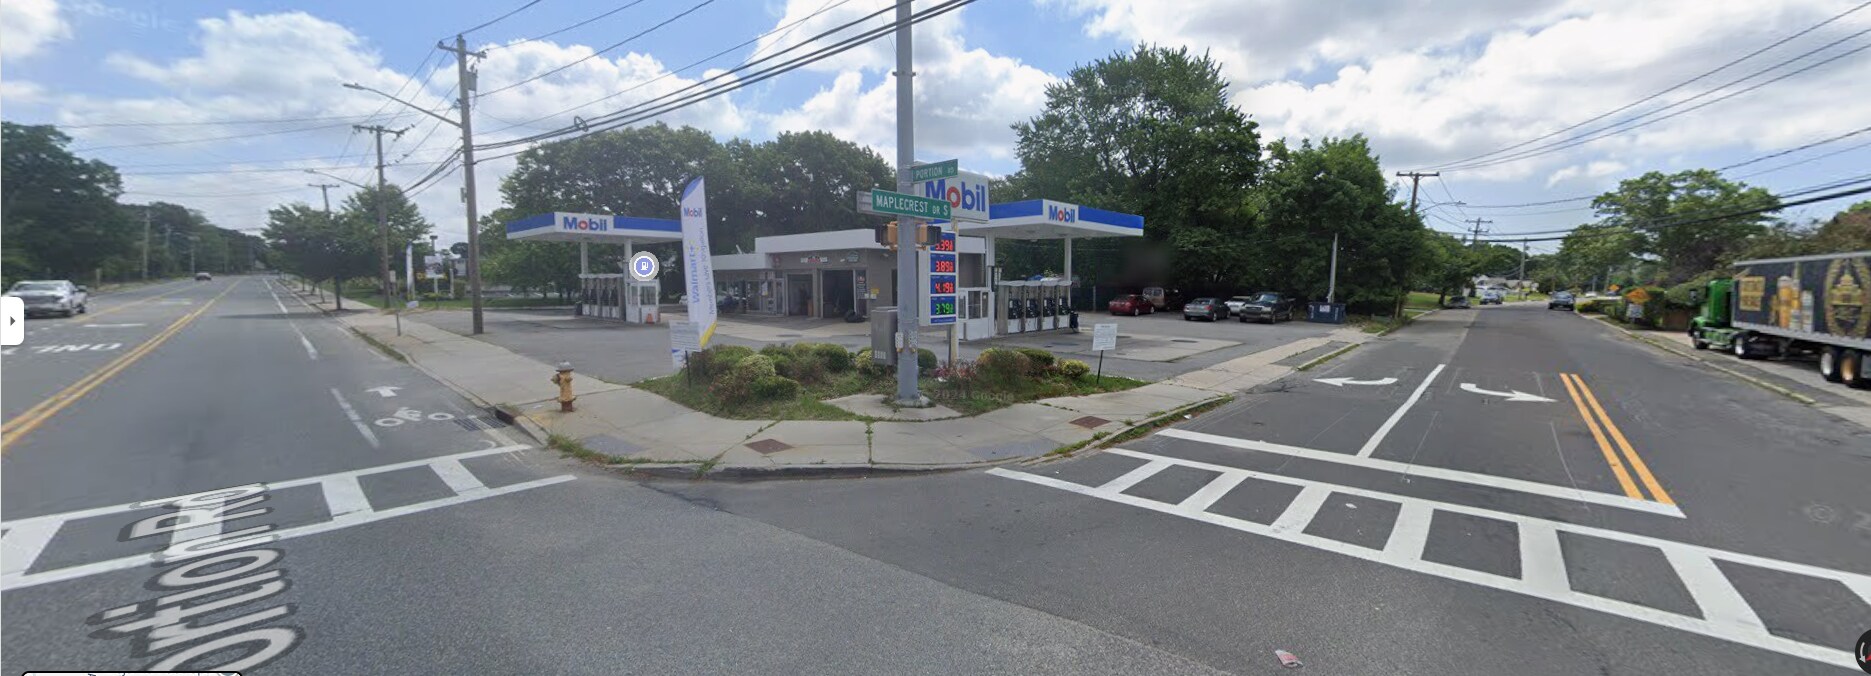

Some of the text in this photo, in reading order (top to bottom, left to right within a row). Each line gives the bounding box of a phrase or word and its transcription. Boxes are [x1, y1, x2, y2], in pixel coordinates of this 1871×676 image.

[916, 167, 943, 179] PORTION
[925, 179, 985, 212] Mobil
[683, 207, 703, 217] Mobil
[876, 195, 928, 213] MAPLECREST
[932, 205, 940, 215] DR
[943, 204, 948, 216] S
[1049, 204, 1075, 223] Mobil
[563, 216, 607, 231] Mobil
